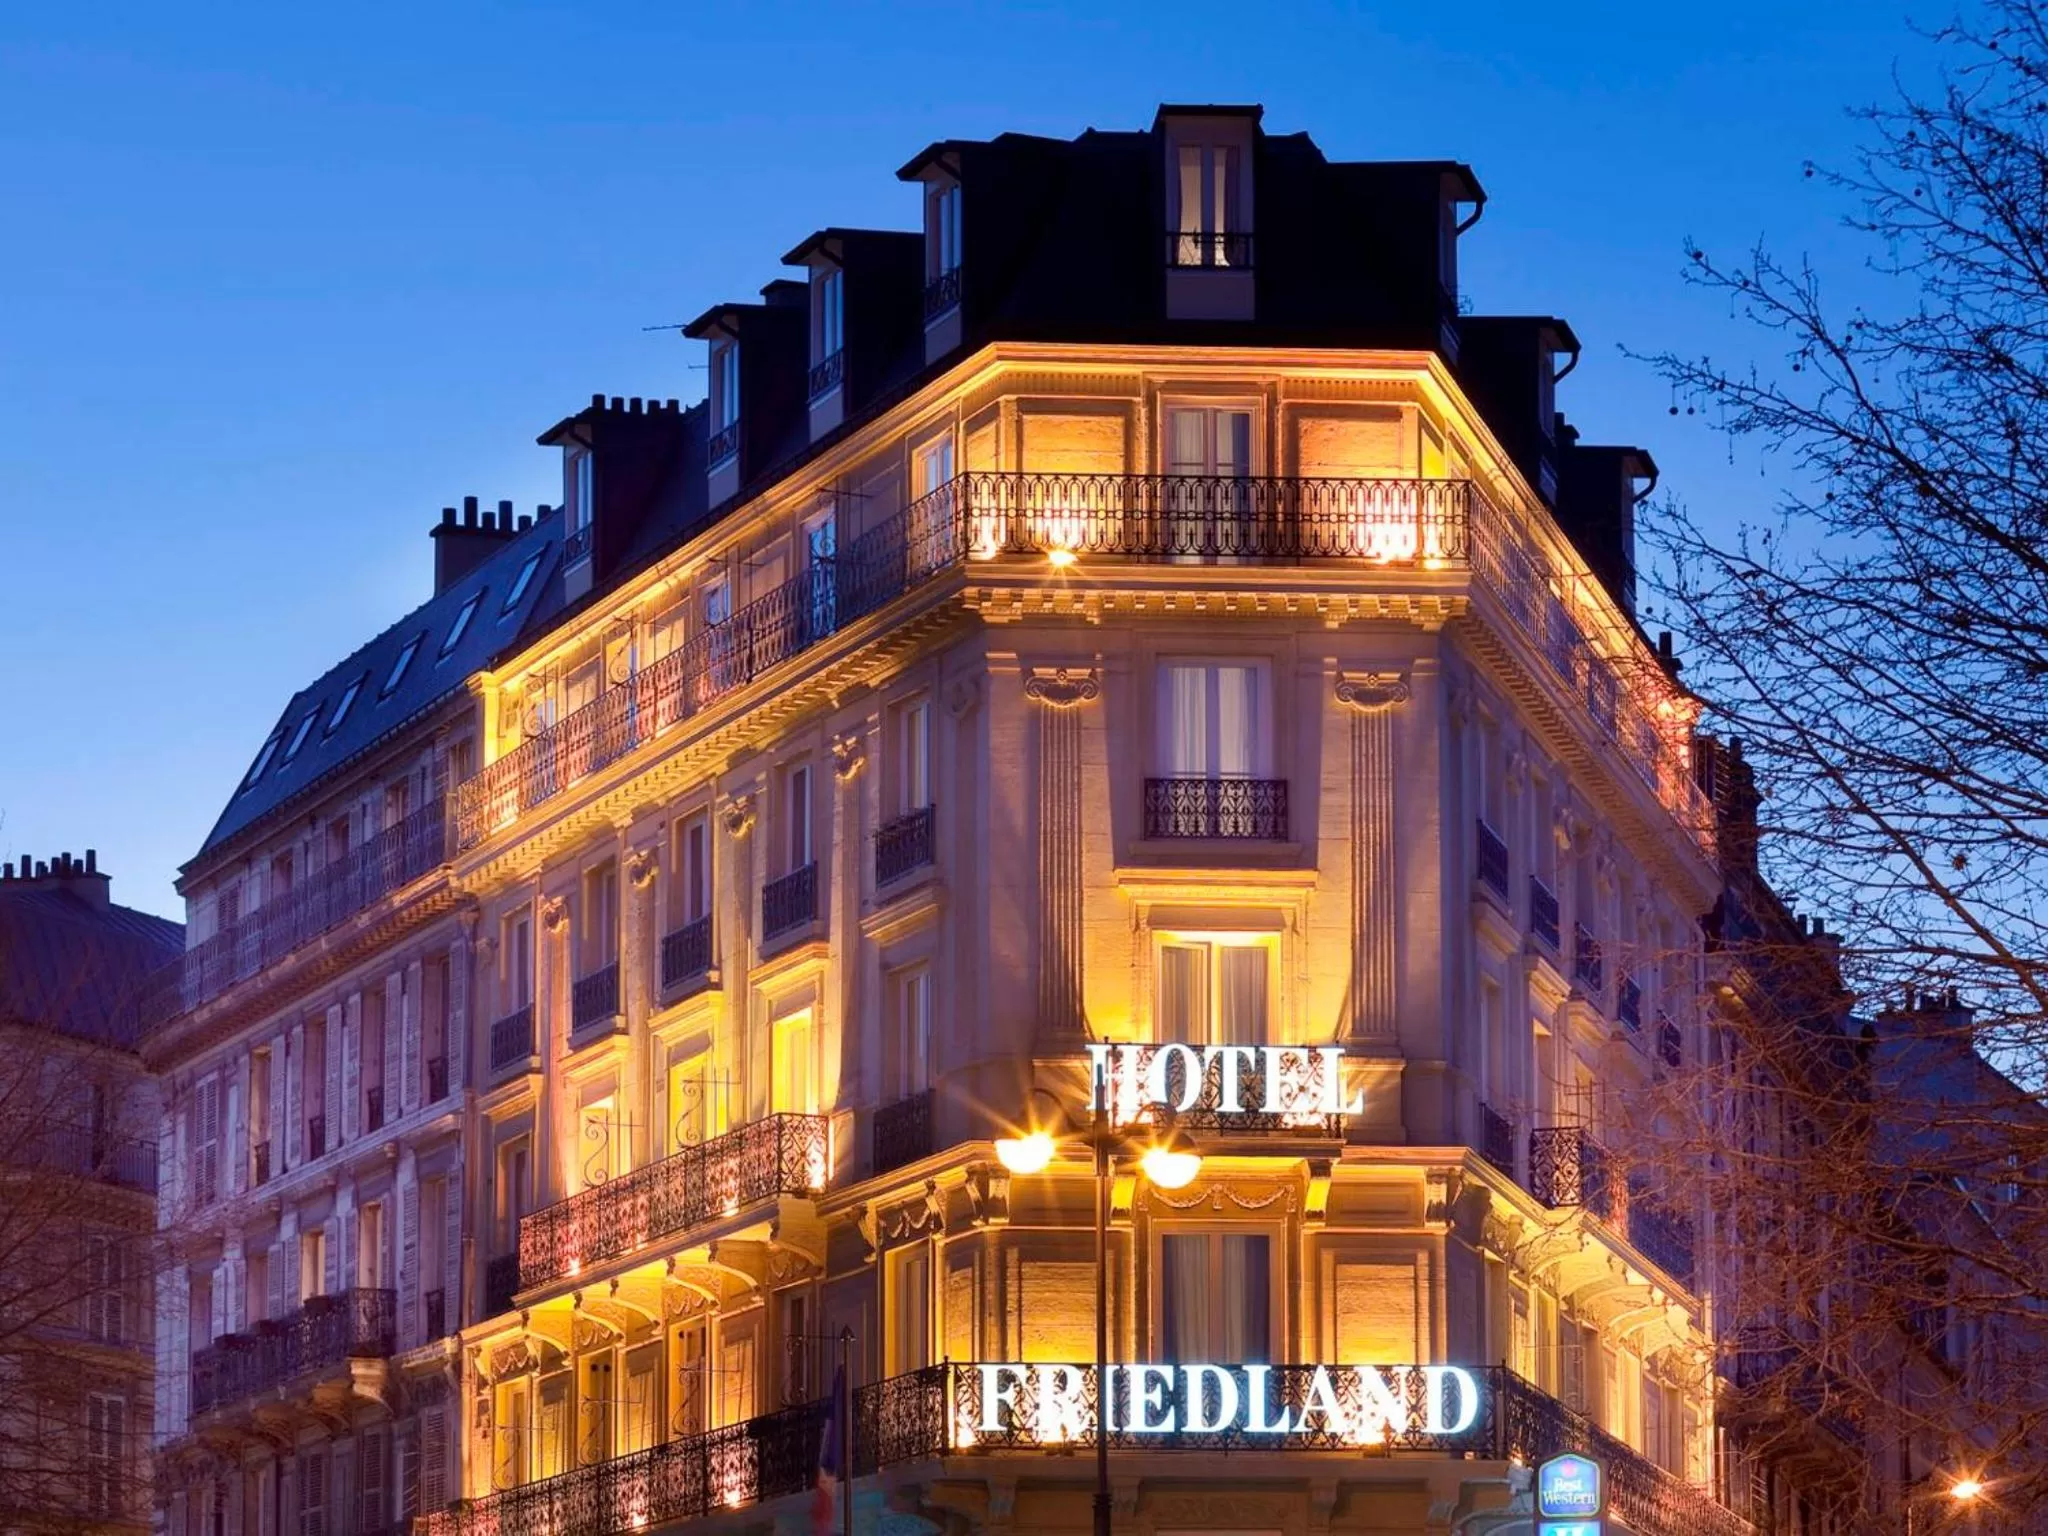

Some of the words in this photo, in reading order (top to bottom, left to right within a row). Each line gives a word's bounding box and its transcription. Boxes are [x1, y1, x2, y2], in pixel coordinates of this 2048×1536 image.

[1085, 1043, 1364, 1115] HOTEL
[977, 1363, 1479, 1434] FRIEDLAND
[1543, 1490, 1595, 1504] Western
[1553, 1477, 1583, 1492] Best
